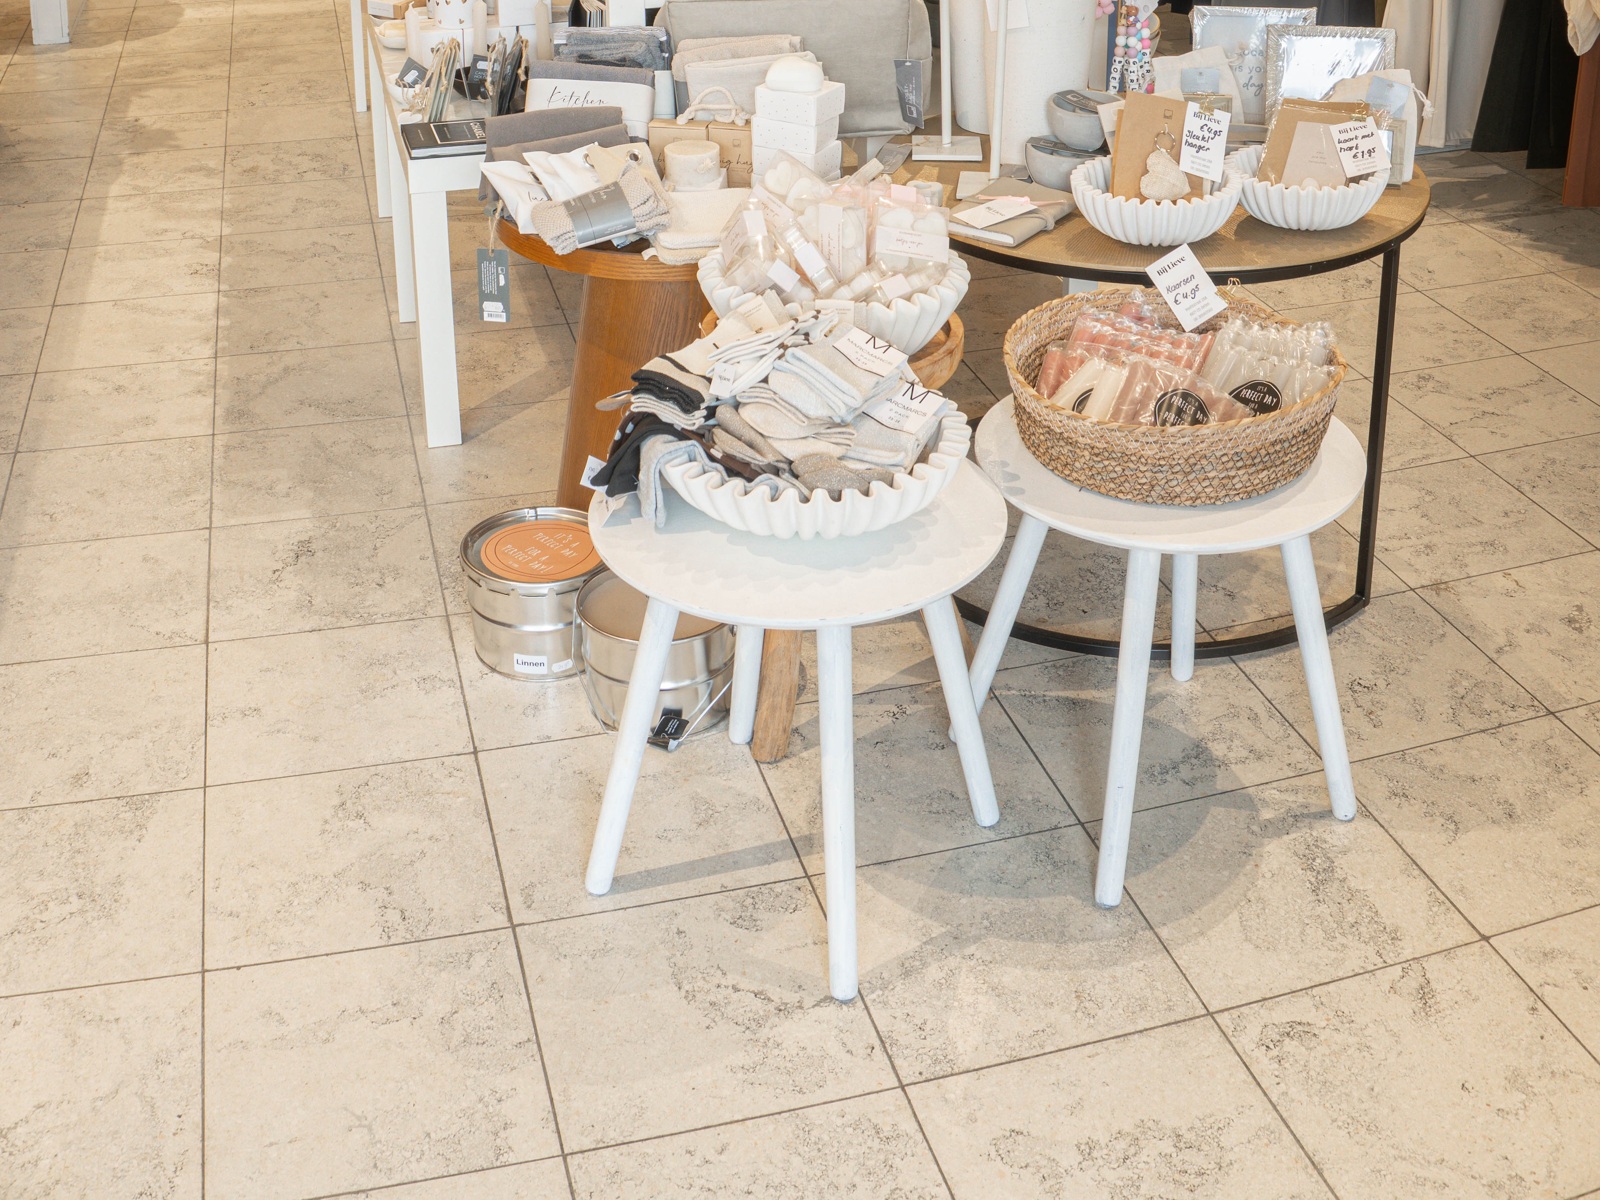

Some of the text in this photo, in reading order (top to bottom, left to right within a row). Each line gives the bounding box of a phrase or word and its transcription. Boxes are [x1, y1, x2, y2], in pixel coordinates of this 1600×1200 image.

[546, 85, 609, 107] Kitchen
[1242, 75, 1264, 97] day
[1193, 111, 1222, 125] Bij Lieve
[1338, 123, 1368, 135] Bij Lieve
[1156, 255, 1186, 276] Bij Lieve
[1165, 273, 1195, 295] Kaarsen
[847, 337, 894, 366] MARCMARCS
[865, 336, 892, 354] M
[902, 383, 930, 404] M
[1240, 388, 1278, 406] PERFECT DAY
[1170, 395, 1208, 424] PERFECT DAY
[533, 532, 578, 559] PERFECT DAY
[553, 532, 573, 544] IT'S
[501, 544, 532, 563] PERFECT
[528, 560, 554, 574] DAY!
[525, 546, 542, 557] FOR
[516, 658, 545, 667] Linnen
